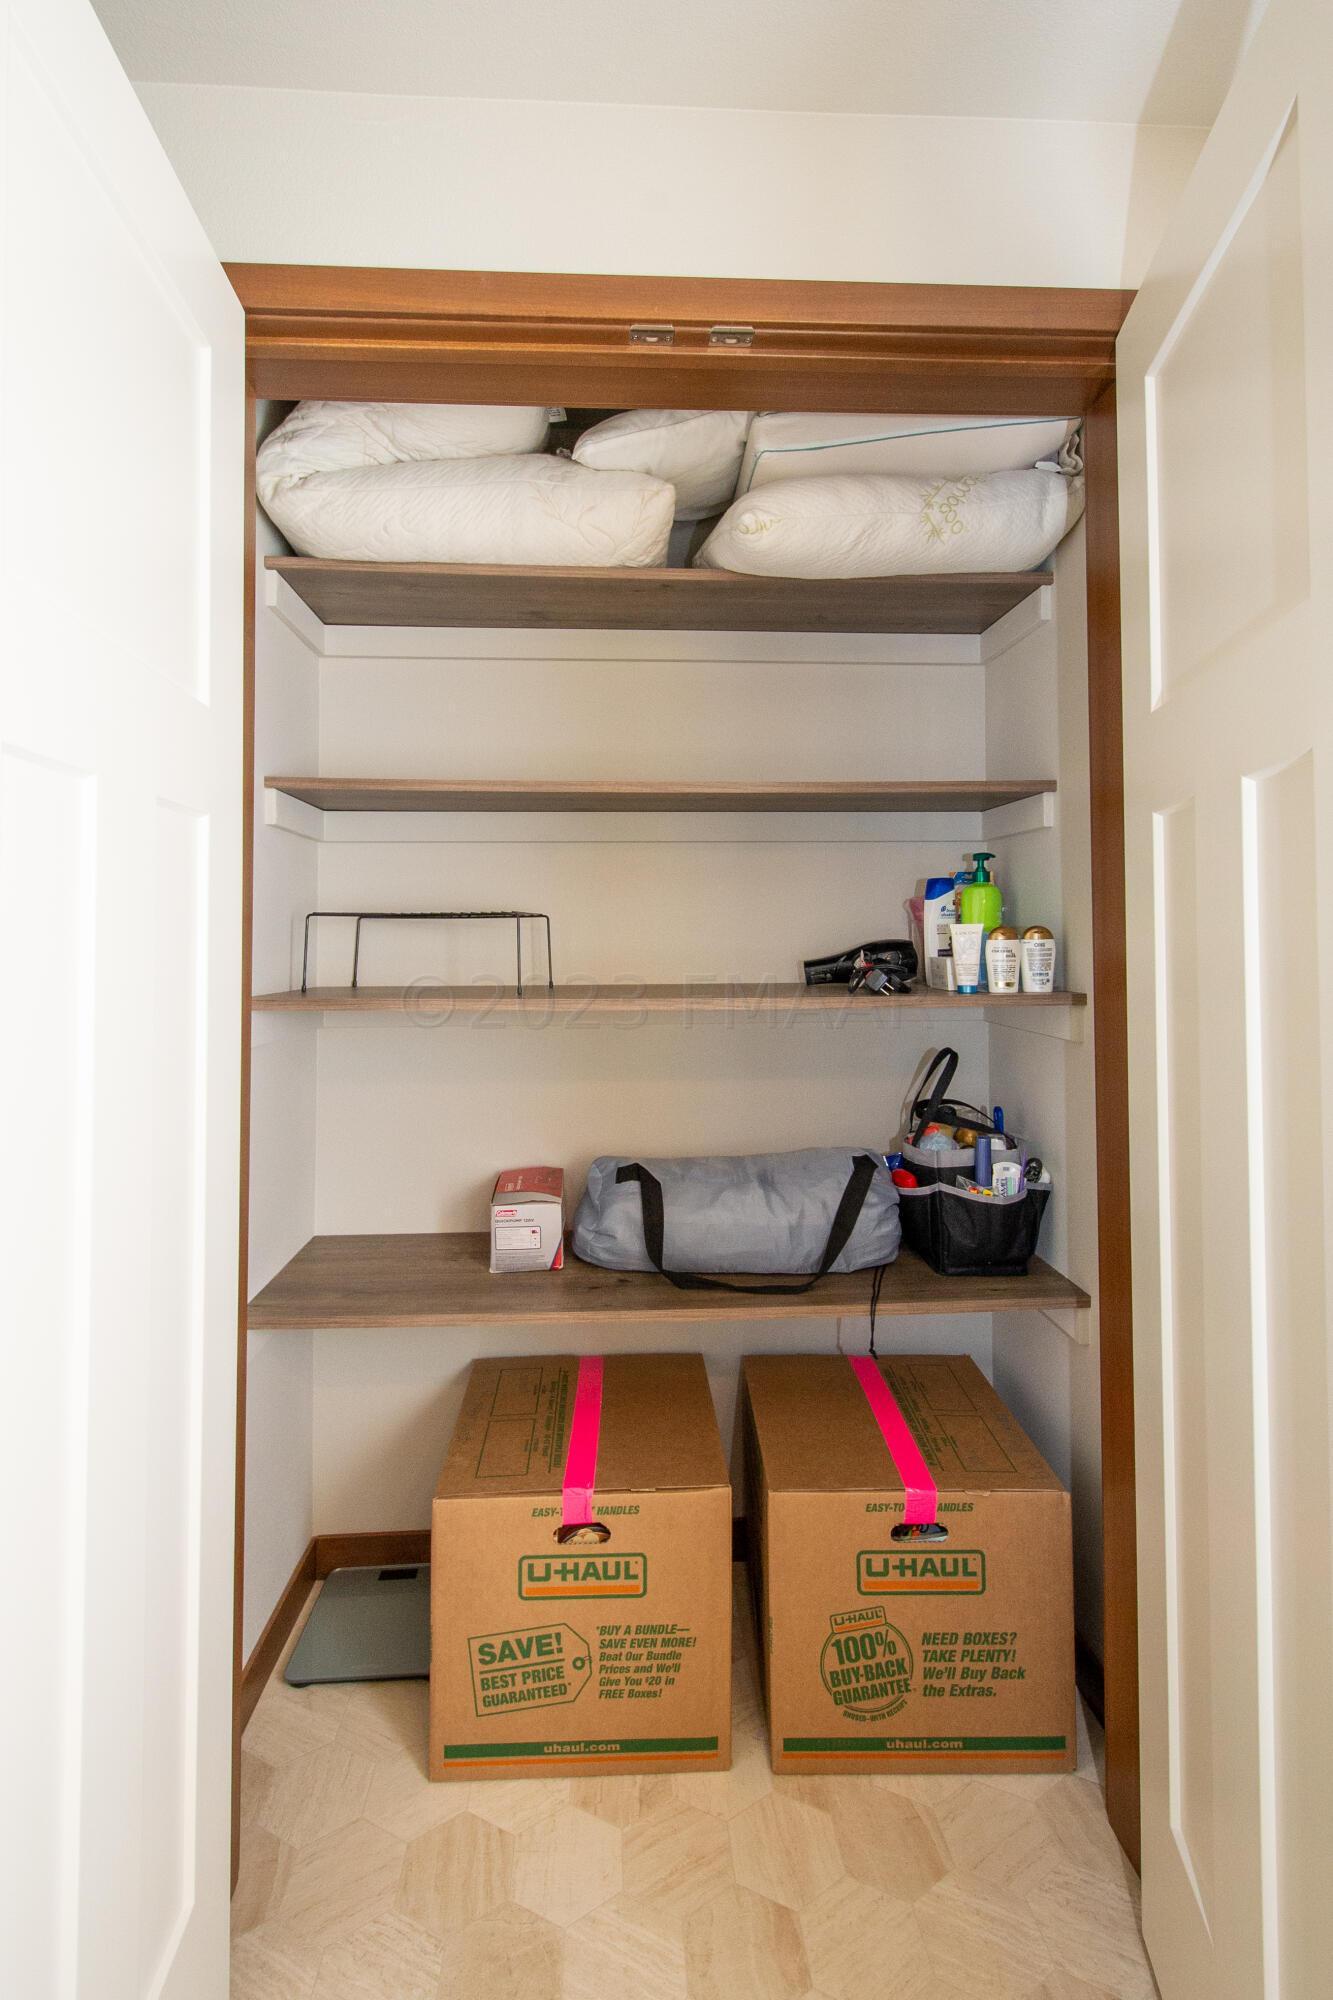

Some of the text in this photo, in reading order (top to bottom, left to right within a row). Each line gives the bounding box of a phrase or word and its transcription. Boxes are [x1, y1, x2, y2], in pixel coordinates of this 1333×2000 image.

[596, 1505, 640, 1516] HANDLES
[937, 1503, 974, 1512] ANDLES
[527, 1561, 639, 1582] U-HAUL
[865, 1557, 978, 1578] U-HAUL
[834, 1609, 883, 1626] U-HAUL
[623, 1624, 632, 1635] A
[599, 1637, 697, 1649] SAVE EVEN MORE!
[921, 1631, 1018, 1645] NEED BOXES?
[478, 1632, 563, 1665] SAVE!
[831, 1629, 897, 1665] 100%
[599, 1650, 682, 1662] Beat Our Bundle
[922, 1648, 1017, 1662] TAKE PLENTY!
[599, 1663, 681, 1674] Prices and We'll
[829, 1658, 908, 1688] BUY-BACK
[922, 1666, 1026, 1682] We'll Buy Back
[480, 1665, 565, 1691] BEST PRICE
[599, 1676, 621, 1687] Give
[624, 1676, 643, 1686] You
[664, 1675, 675, 1685] in
[482, 1682, 570, 1708] GUARANTEED
[599, 1688, 663, 1699] FREE Boxes!
[832, 1677, 911, 1706] GUARANTEE
[922, 1683, 997, 1697] the Extras.
[543, 1741, 621, 1754] uhaul.com
[886, 1738, 964, 1750] uhaul.com
